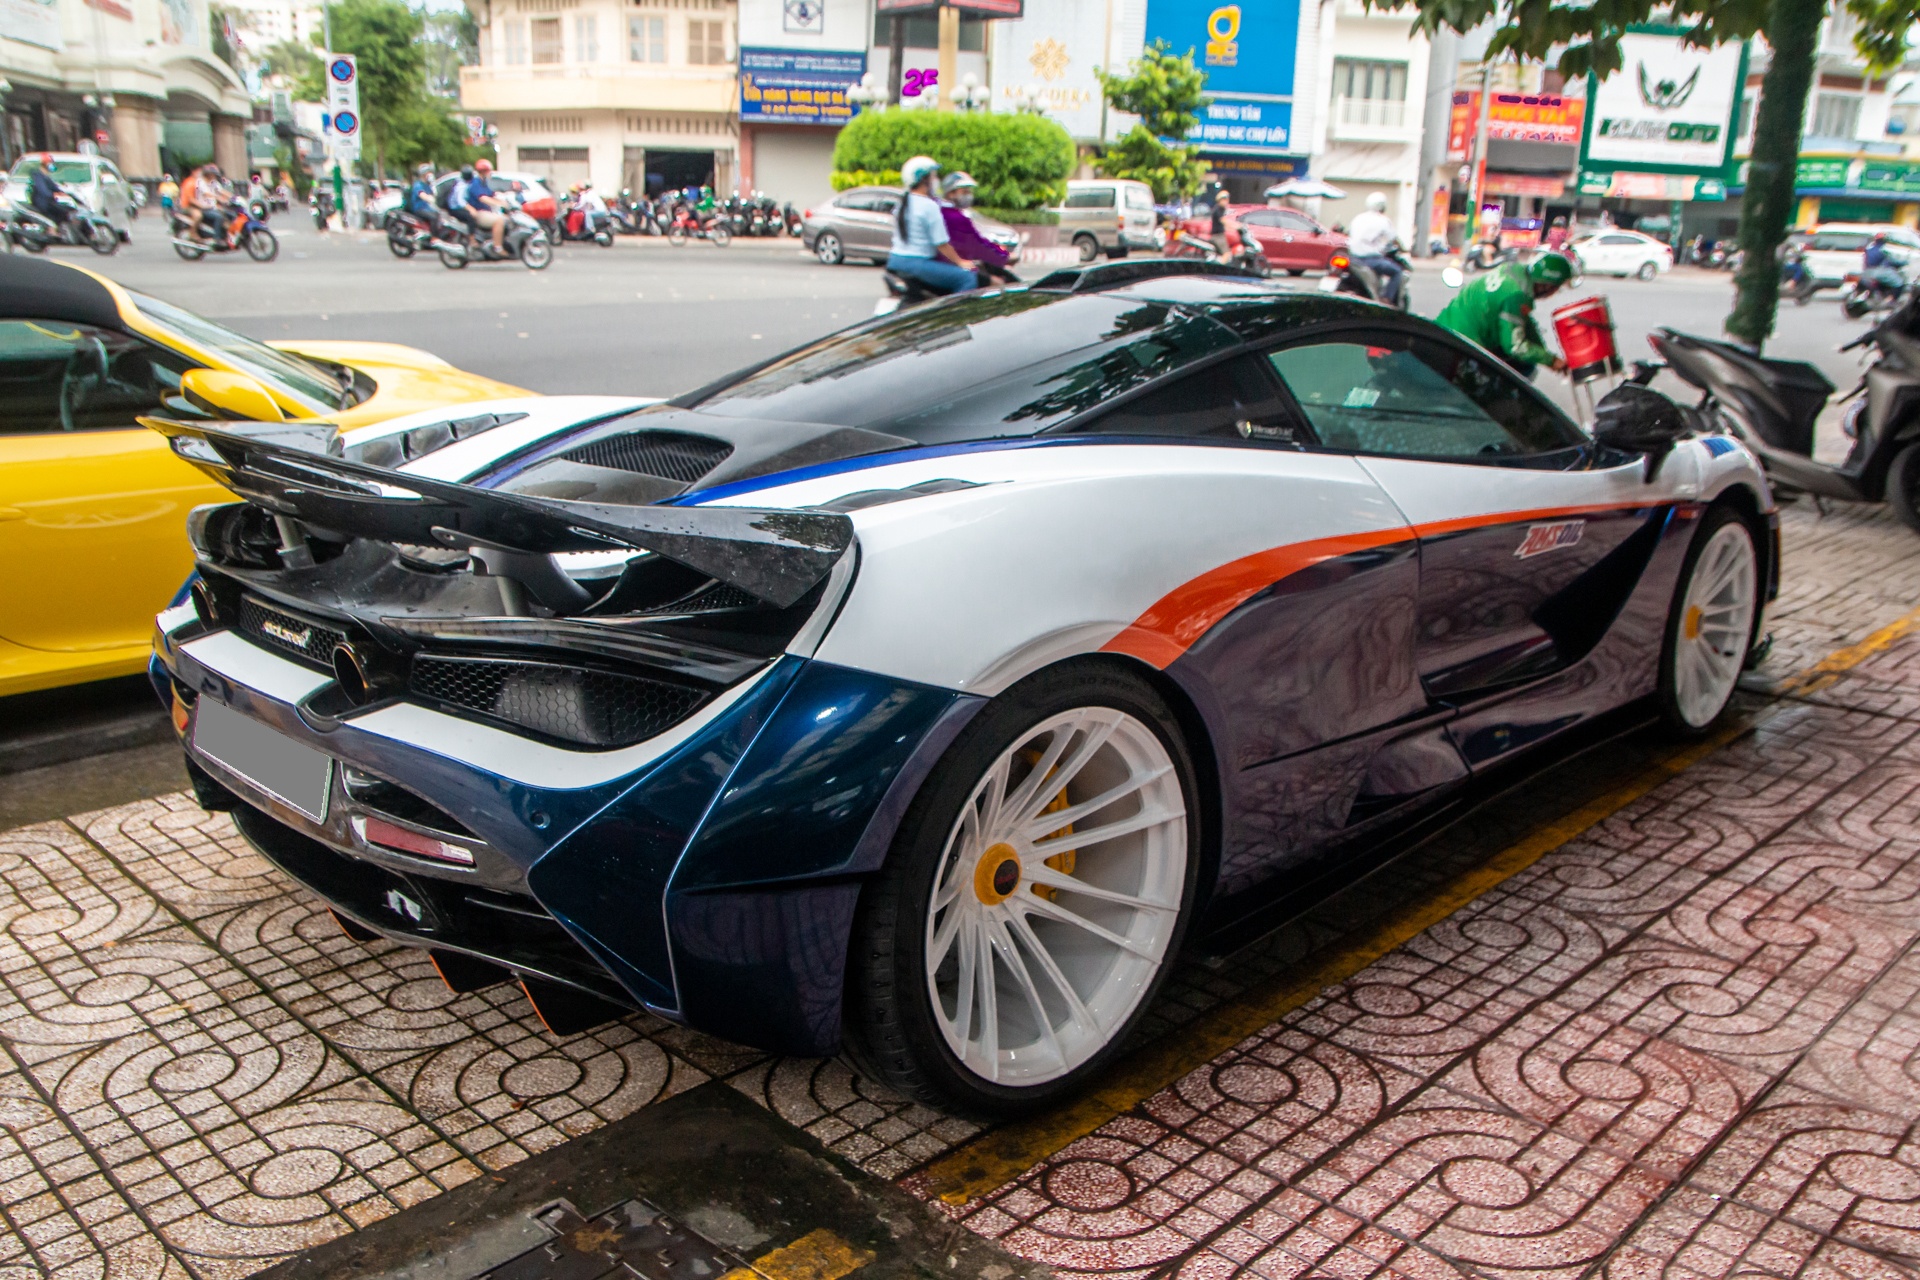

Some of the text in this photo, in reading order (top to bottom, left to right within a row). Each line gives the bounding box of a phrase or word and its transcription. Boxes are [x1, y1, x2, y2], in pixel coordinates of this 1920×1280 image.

[1208, 103, 1261, 121] TRUNG TÂM
[1516, 522, 1584, 556] AMSOIL
